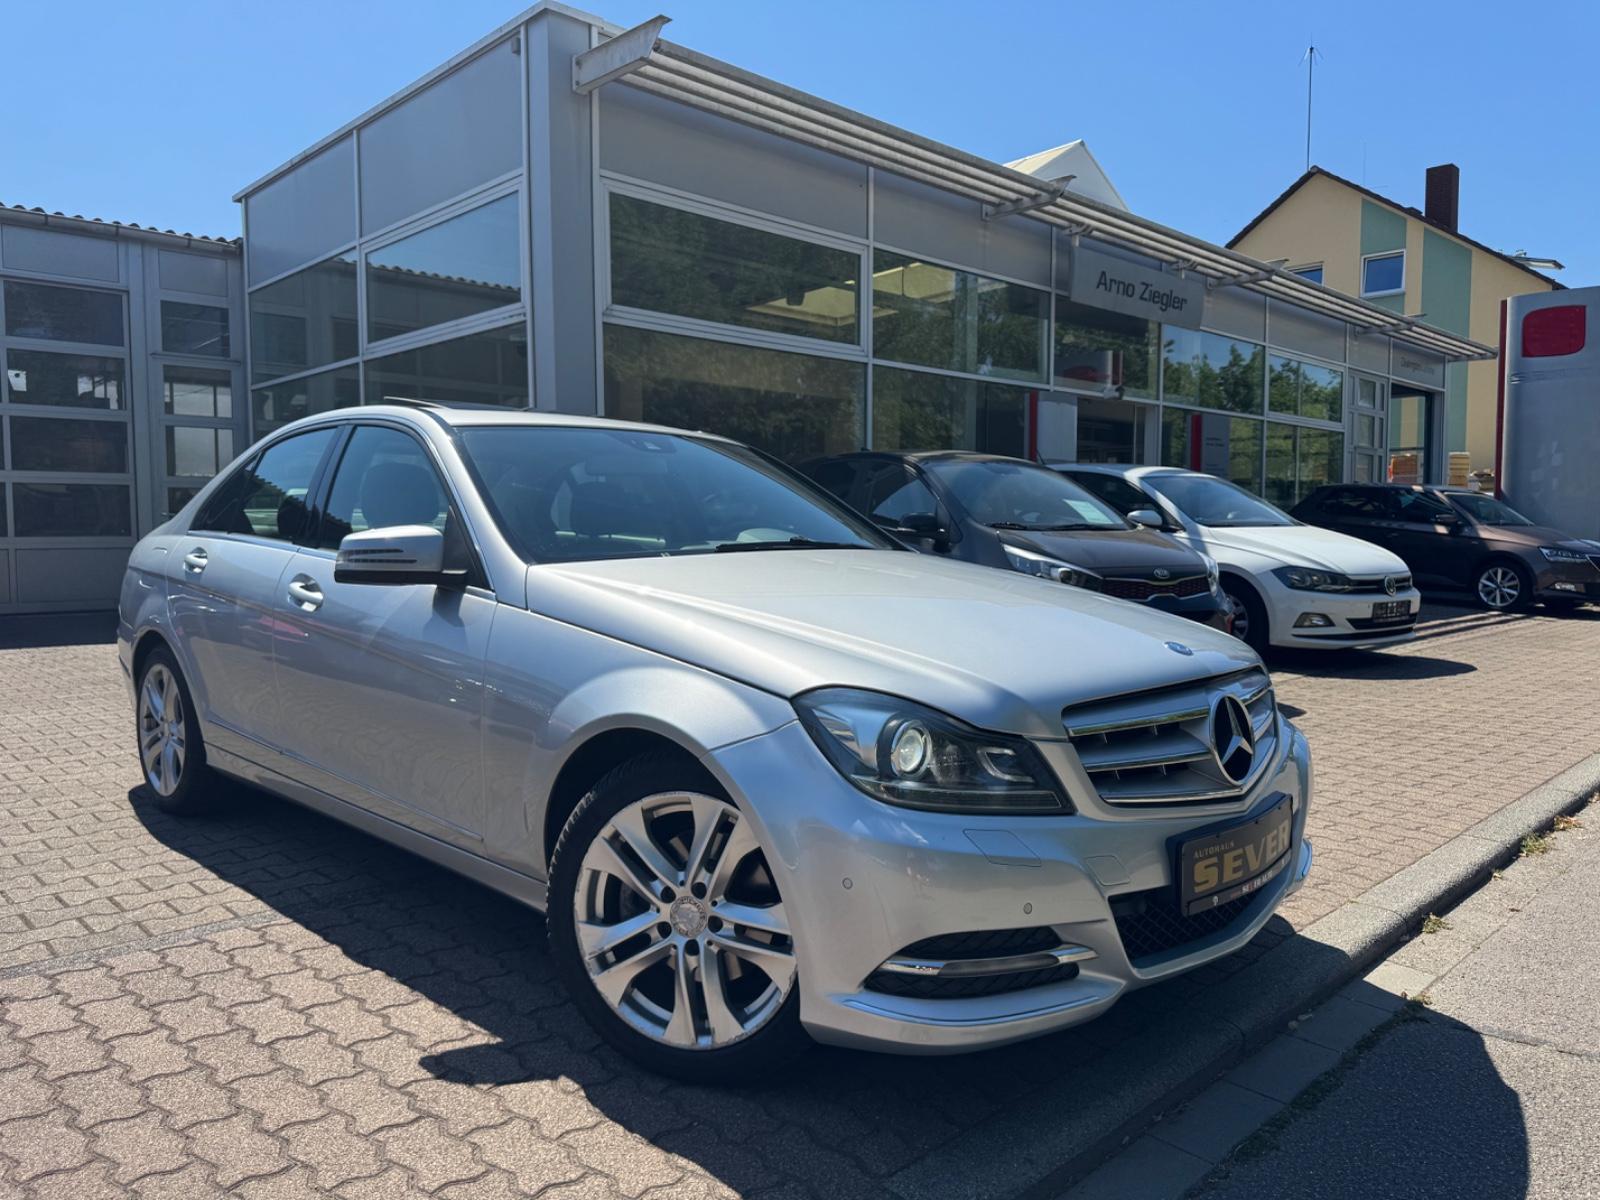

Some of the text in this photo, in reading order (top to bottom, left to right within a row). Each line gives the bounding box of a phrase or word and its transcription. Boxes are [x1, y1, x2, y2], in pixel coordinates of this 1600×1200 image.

[1096, 270, 1187, 312] Arno Ziegler
[1193, 820, 1290, 893] SEVER
